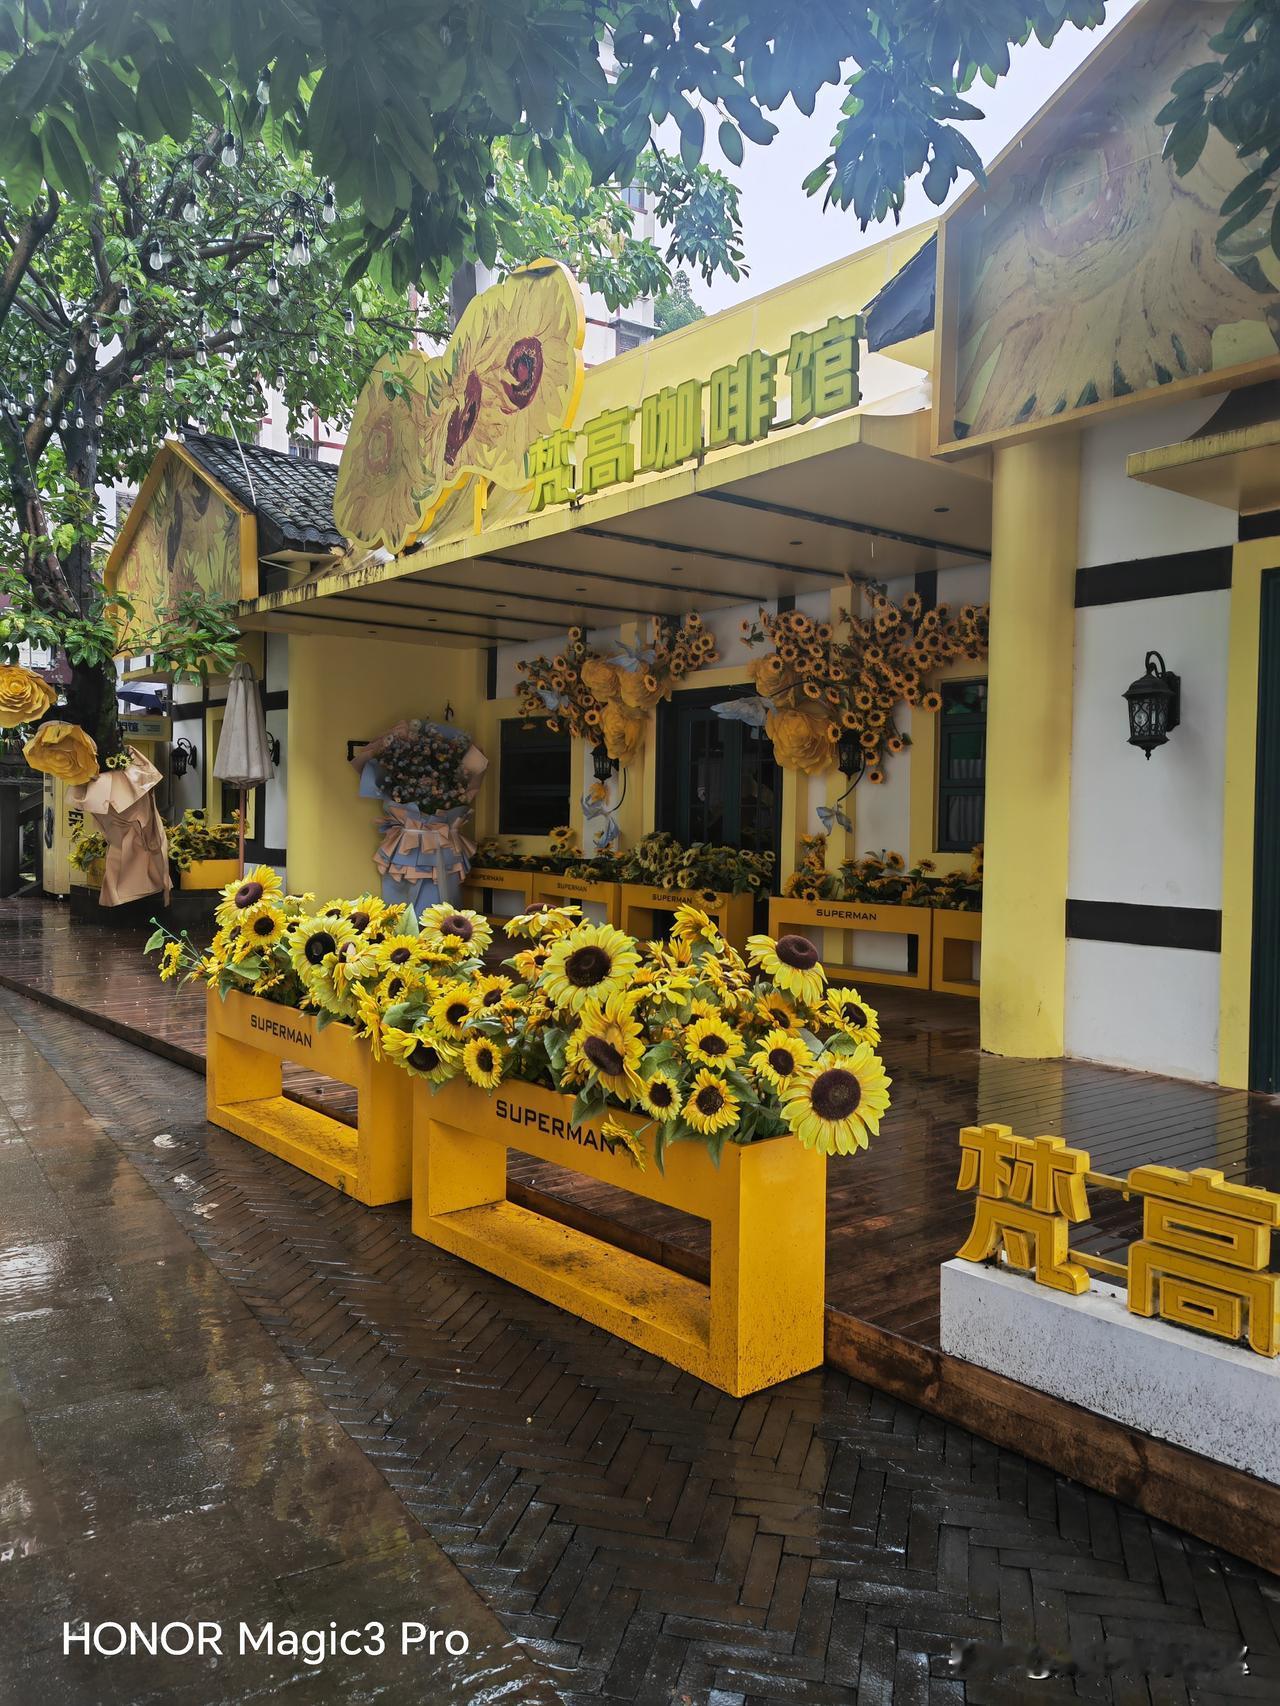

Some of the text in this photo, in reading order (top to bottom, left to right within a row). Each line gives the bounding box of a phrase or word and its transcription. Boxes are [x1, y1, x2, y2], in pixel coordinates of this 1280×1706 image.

[527, 314, 865, 513] 梵高咖啡馆
[652, 893, 693, 904] SUPERMAN
[816, 908, 877, 921] SUPERMAN
[250, 1014, 312, 1048] SUPERMAN
[955, 1123, 1280, 1359] 梵高
